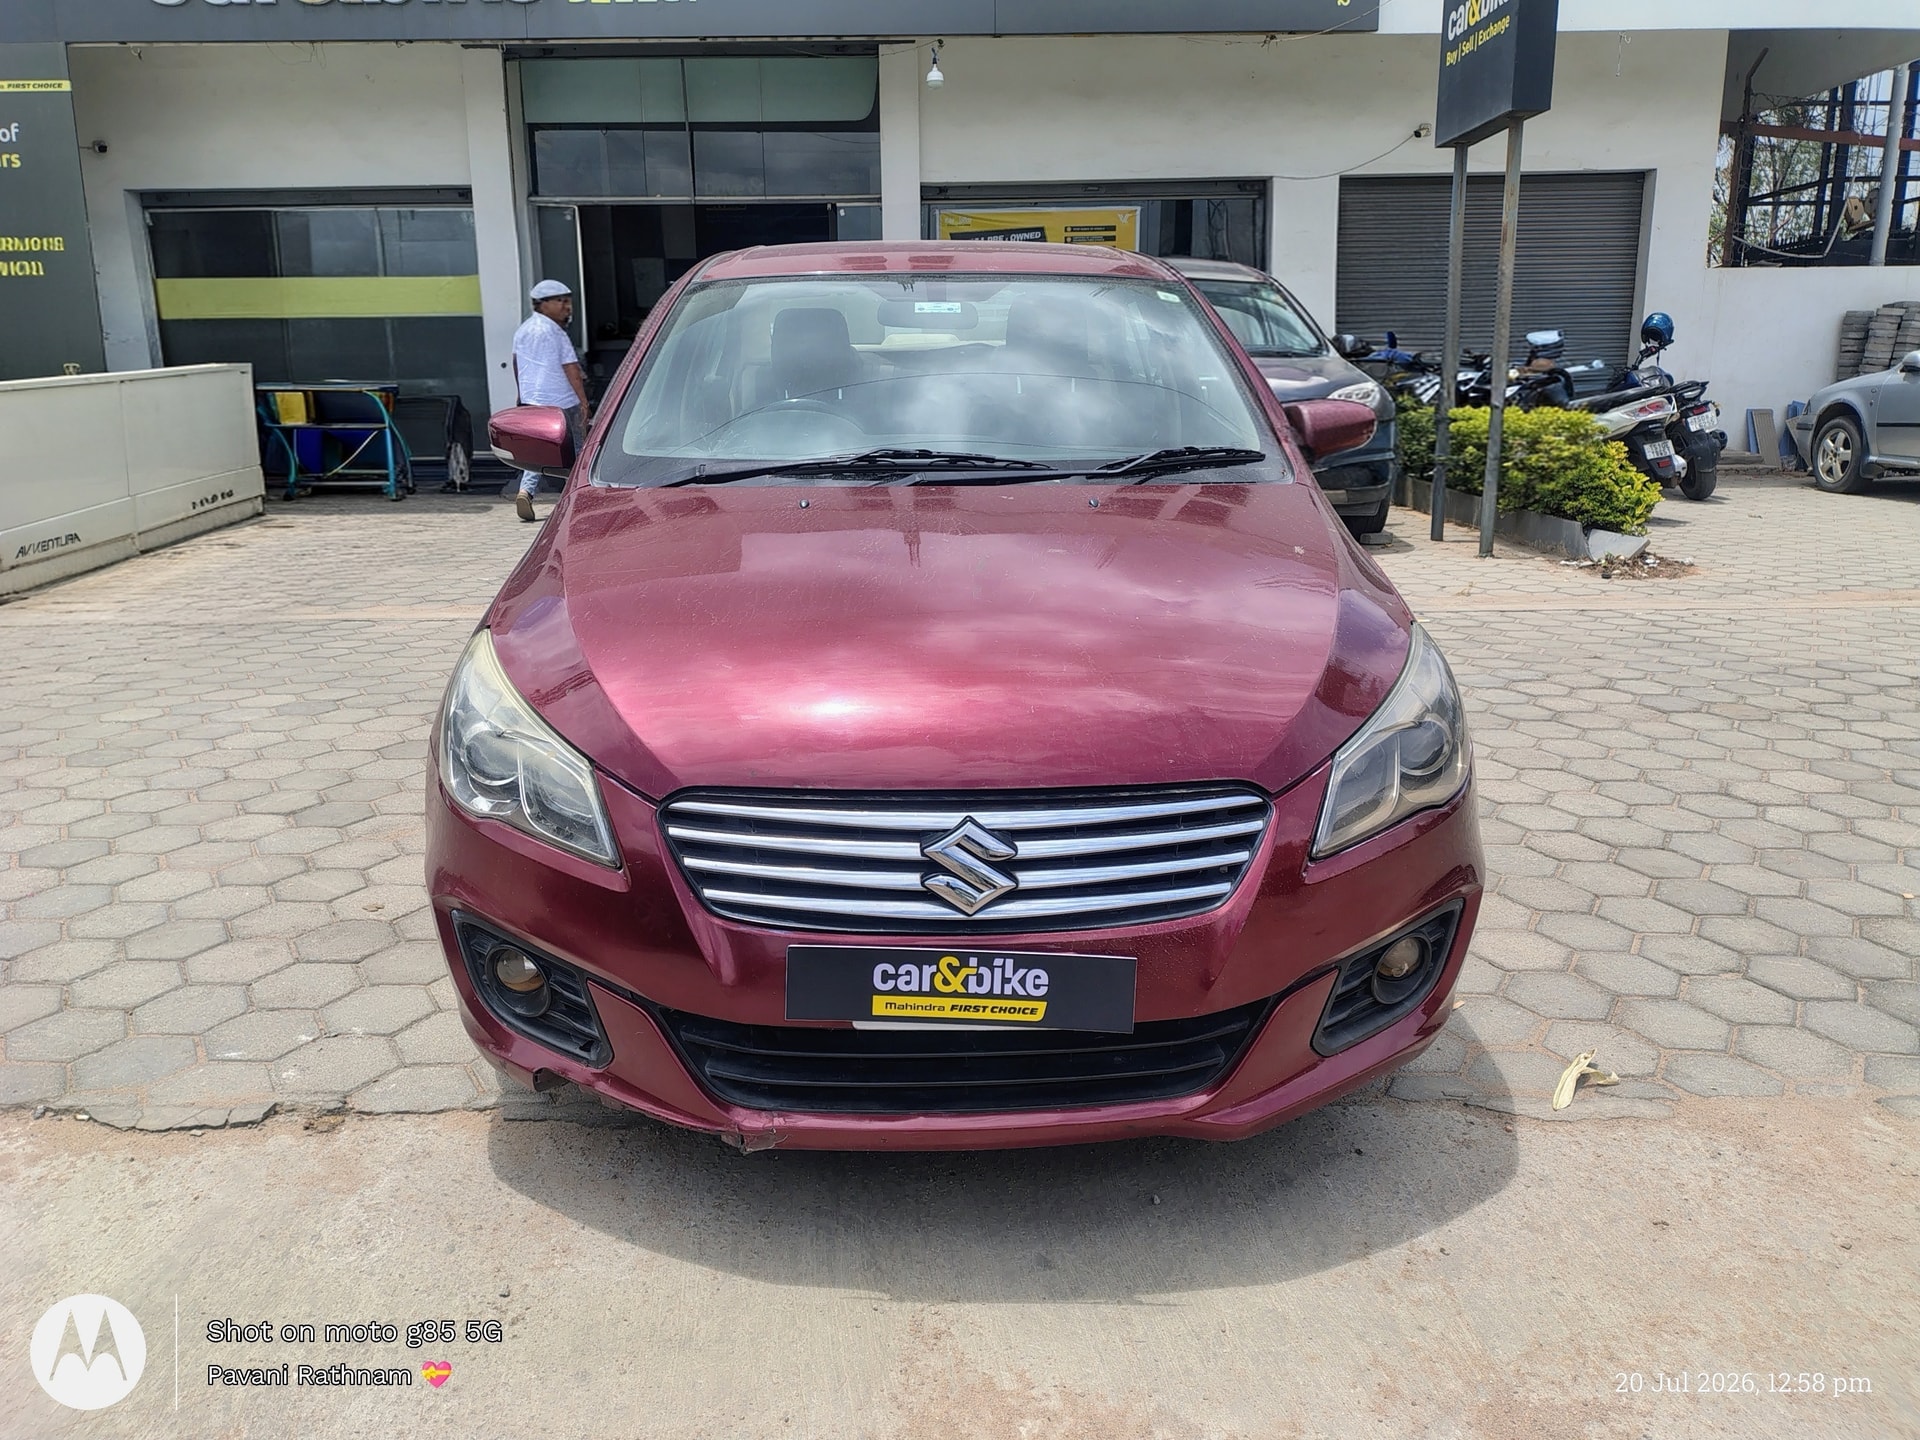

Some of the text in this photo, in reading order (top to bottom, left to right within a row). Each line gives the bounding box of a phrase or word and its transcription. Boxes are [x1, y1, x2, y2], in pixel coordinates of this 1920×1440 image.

[1446, 49, 1458, 66] Buy
[1461, 35, 1474, 56] Sell
[1478, 15, 1510, 45] Exchange
[0, 122, 19, 142] of
[0, 153, 22, 168] rs
[15, 532, 81, 559] AVVENTURA
[873, 956, 1049, 996] car&bike
[885, 1002, 1039, 1015] Mahindra FIRST CHOICE
